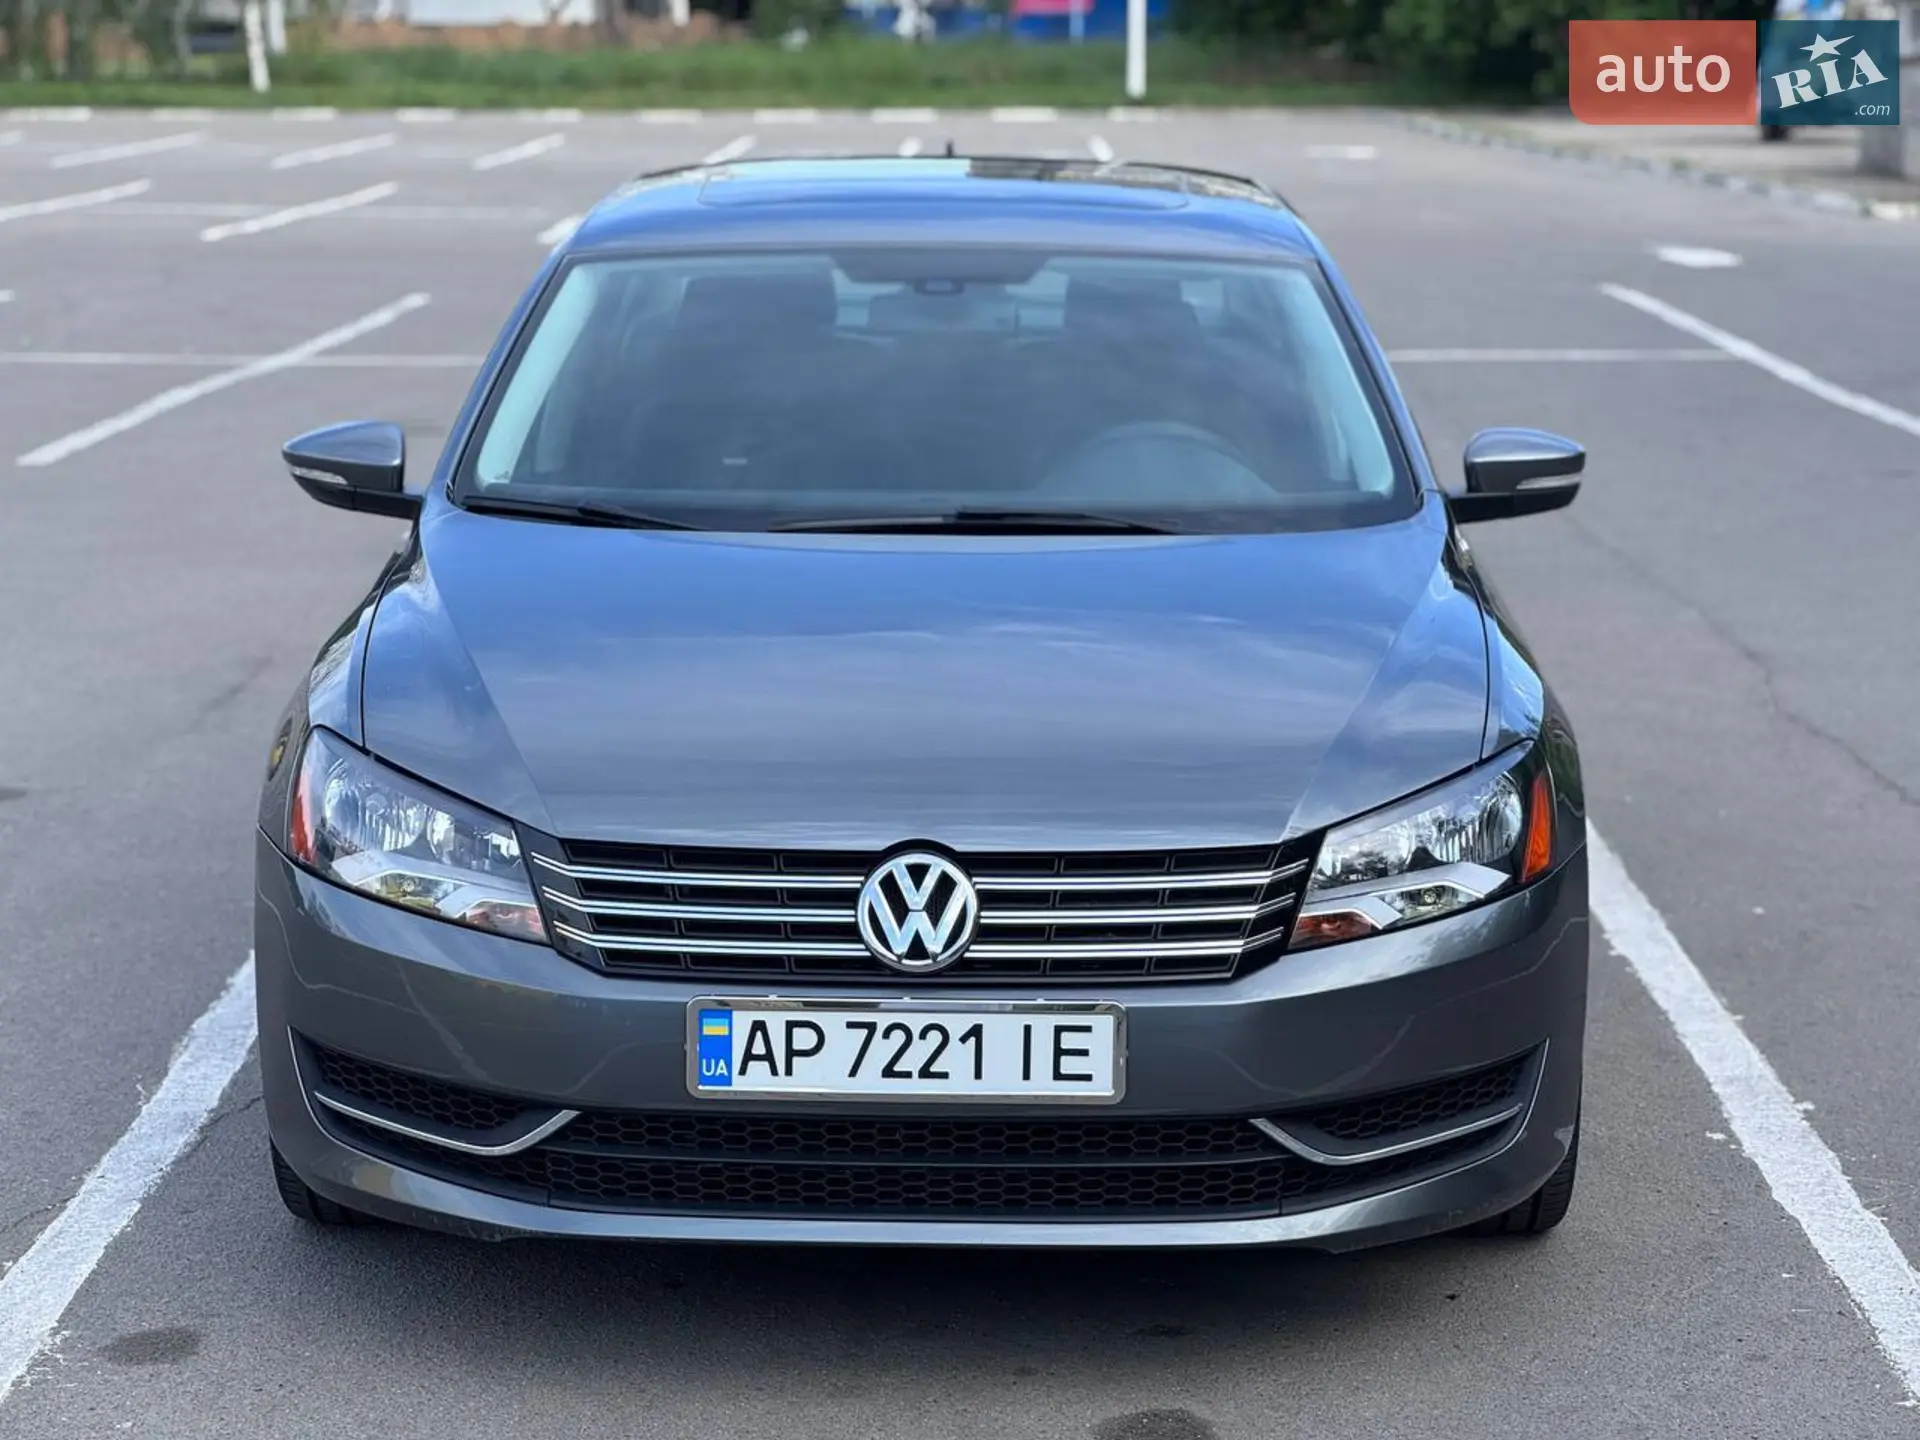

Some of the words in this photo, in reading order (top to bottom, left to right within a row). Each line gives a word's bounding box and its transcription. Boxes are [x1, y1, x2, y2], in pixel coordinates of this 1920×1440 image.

[864, 858, 970, 961] VW
[702, 1058, 729, 1077] UA
[737, 1019, 826, 1077] AP
[845, 1021, 984, 1081] 7221
[1021, 1023, 1094, 1082] IE
